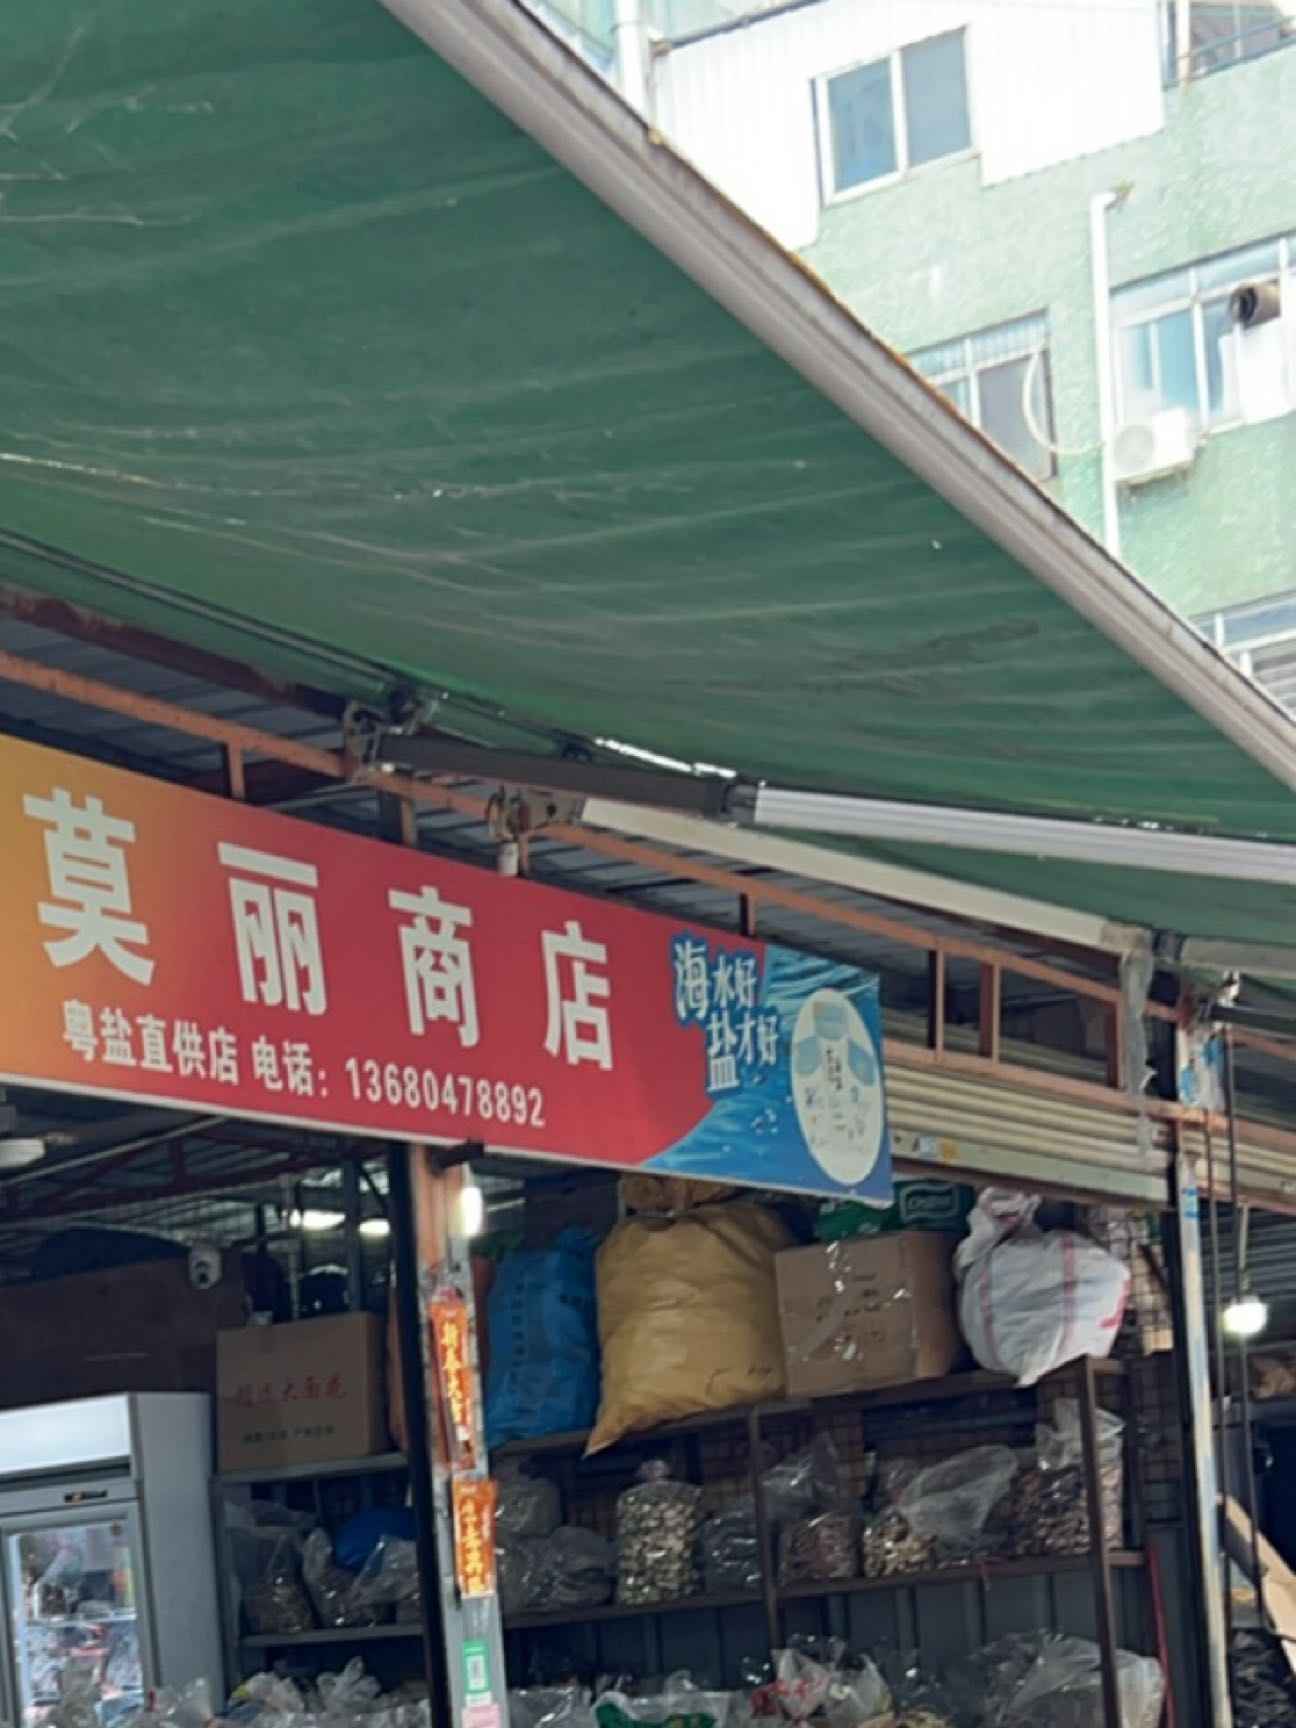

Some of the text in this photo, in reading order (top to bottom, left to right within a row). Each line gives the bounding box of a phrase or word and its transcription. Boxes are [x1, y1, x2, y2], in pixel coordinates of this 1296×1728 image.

[23, 786, 614, 1071] 莫丽商店
[61, 998, 240, 1087] 粤盐直供店
[344, 1057, 545, 1128] 13680478892
